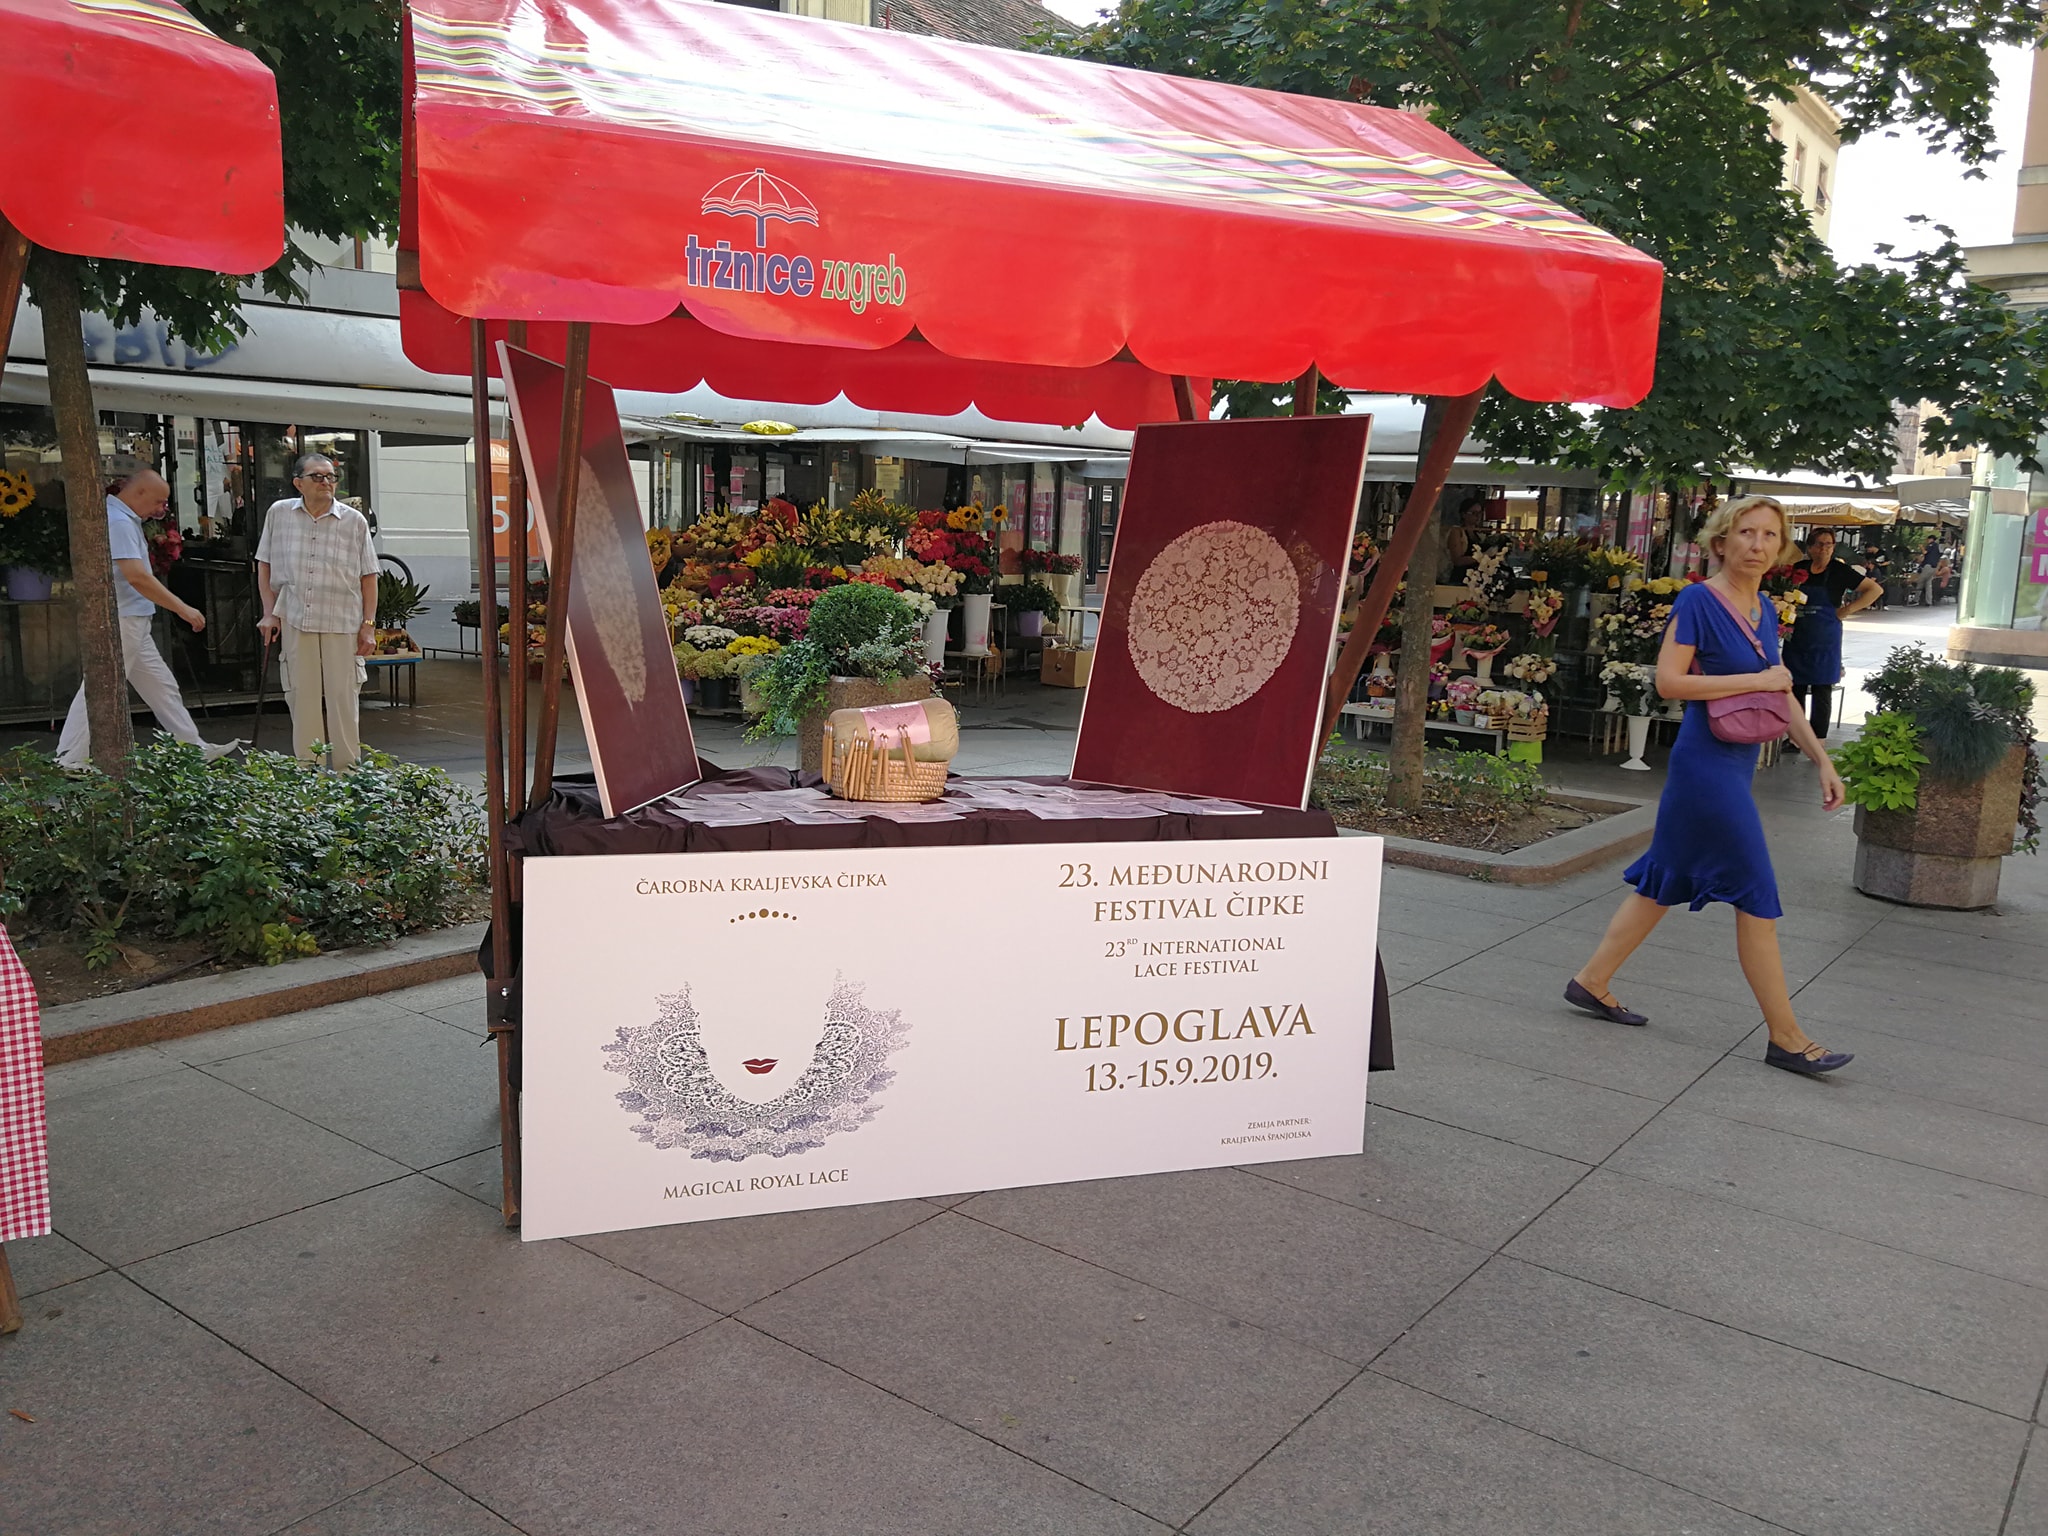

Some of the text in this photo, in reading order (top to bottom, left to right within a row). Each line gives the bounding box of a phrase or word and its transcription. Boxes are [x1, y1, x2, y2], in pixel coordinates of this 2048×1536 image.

[685, 234, 907, 315] tržnice zagreb
[636, 871, 887, 895] ČAROBNA KRALJEVSKA ČIPKA
[1058, 860, 1329, 888] 23. MEĐUNARODNI
[1093, 891, 1305, 922] FESTIVAL ČIPKE
[1143, 936, 1286, 956] INTERNATIONAL
[1134, 959, 1260, 978] LACE FESTIVAL
[1054, 1002, 1317, 1052] LEPOGLAVA
[1084, 1051, 1279, 1093] 13.-15.9.2019.
[1220, 1130, 1312, 1146] KRALJEVINA ŠPANJOLSKA
[1247, 1121, 1275, 1130] ZEMLJA
[663, 1168, 849, 1201] MAGICAL ROYAL LACE
